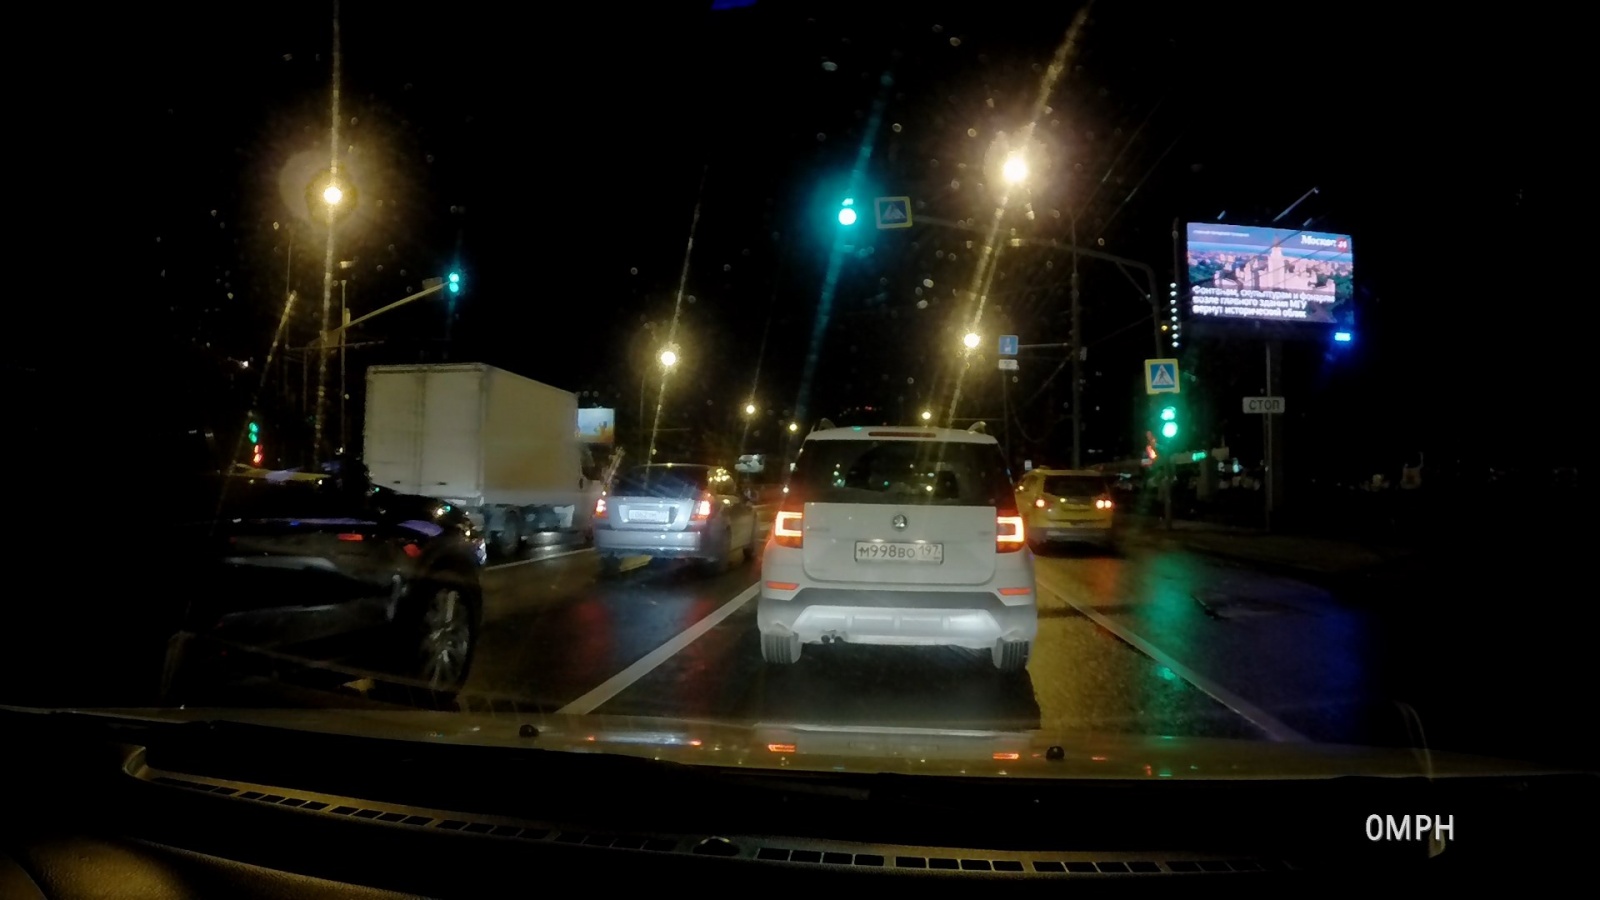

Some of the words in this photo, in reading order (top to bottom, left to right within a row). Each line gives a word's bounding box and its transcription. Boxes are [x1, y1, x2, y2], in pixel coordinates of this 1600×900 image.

[1240, 289, 1292, 300] скульптурам
[1192, 296, 1219, 304] возле
[1220, 297, 1258, 306] главного
[1259, 298, 1289, 307] здания
[1290, 299, 1307, 309] МГУ
[1192, 305, 1223, 316] вернут
[1224, 306, 1281, 317] исторический
[1282, 307, 1307, 318] облик
[1248, 399, 1280, 411] СТОП
